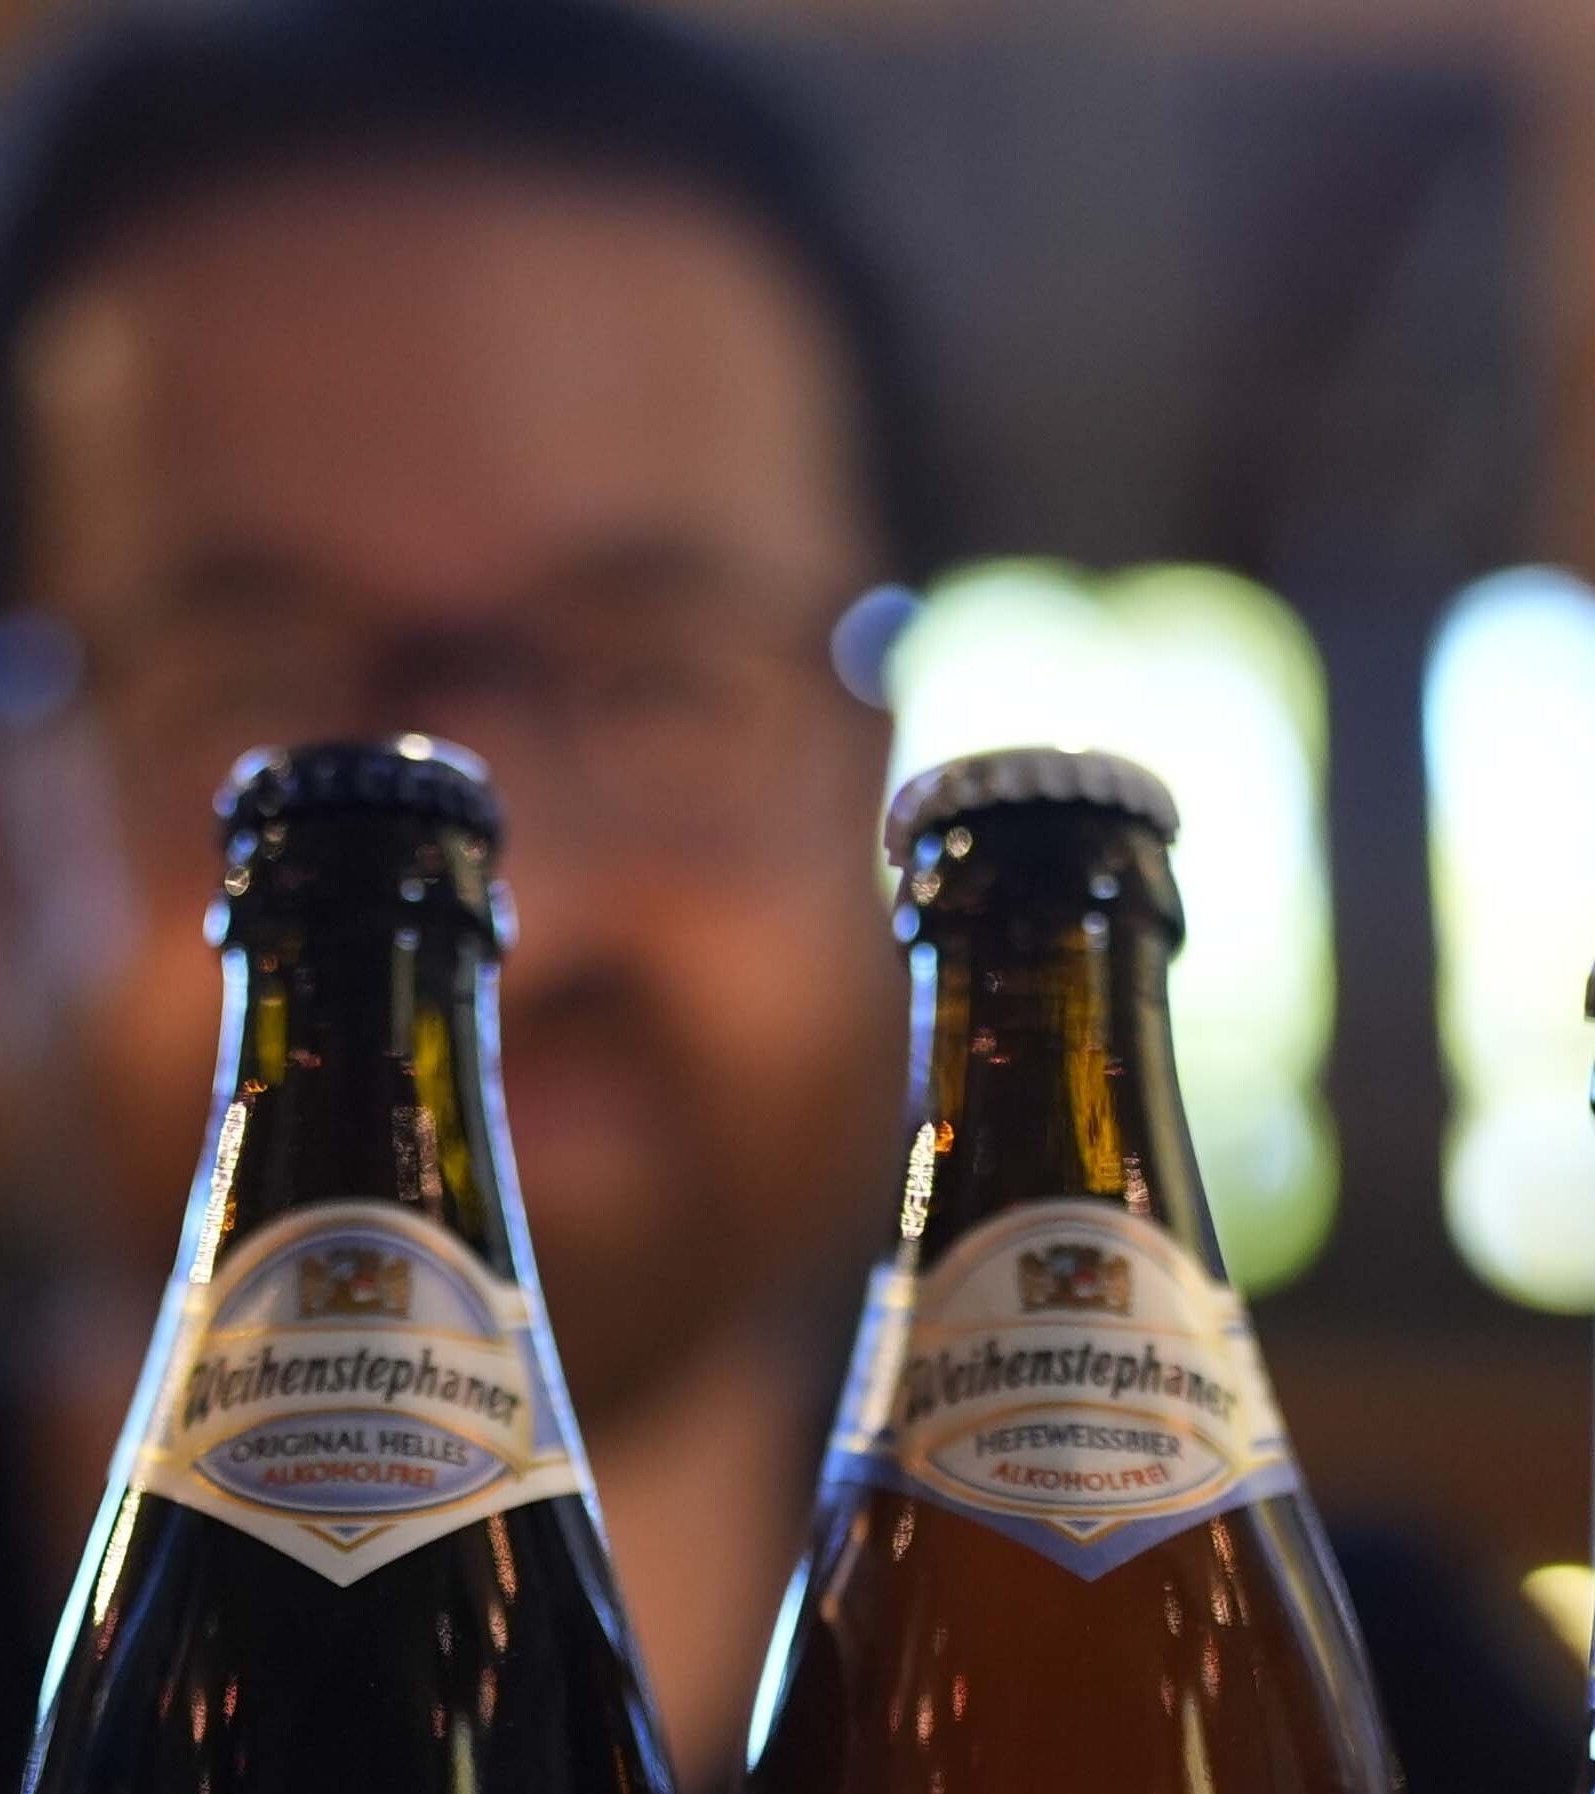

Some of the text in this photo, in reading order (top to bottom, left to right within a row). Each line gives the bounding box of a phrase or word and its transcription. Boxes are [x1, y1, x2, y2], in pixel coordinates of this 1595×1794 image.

[183, 1345, 519, 1428] Weihenstephaner
[229, 1428, 469, 1465] ORIGINAL HELLES
[976, 1424, 1182, 1458] HEFEWEISSBIER
[260, 1462, 437, 1488] ALKOHOLFREI
[990, 1462, 1172, 1492] ALKOHOLFREI
